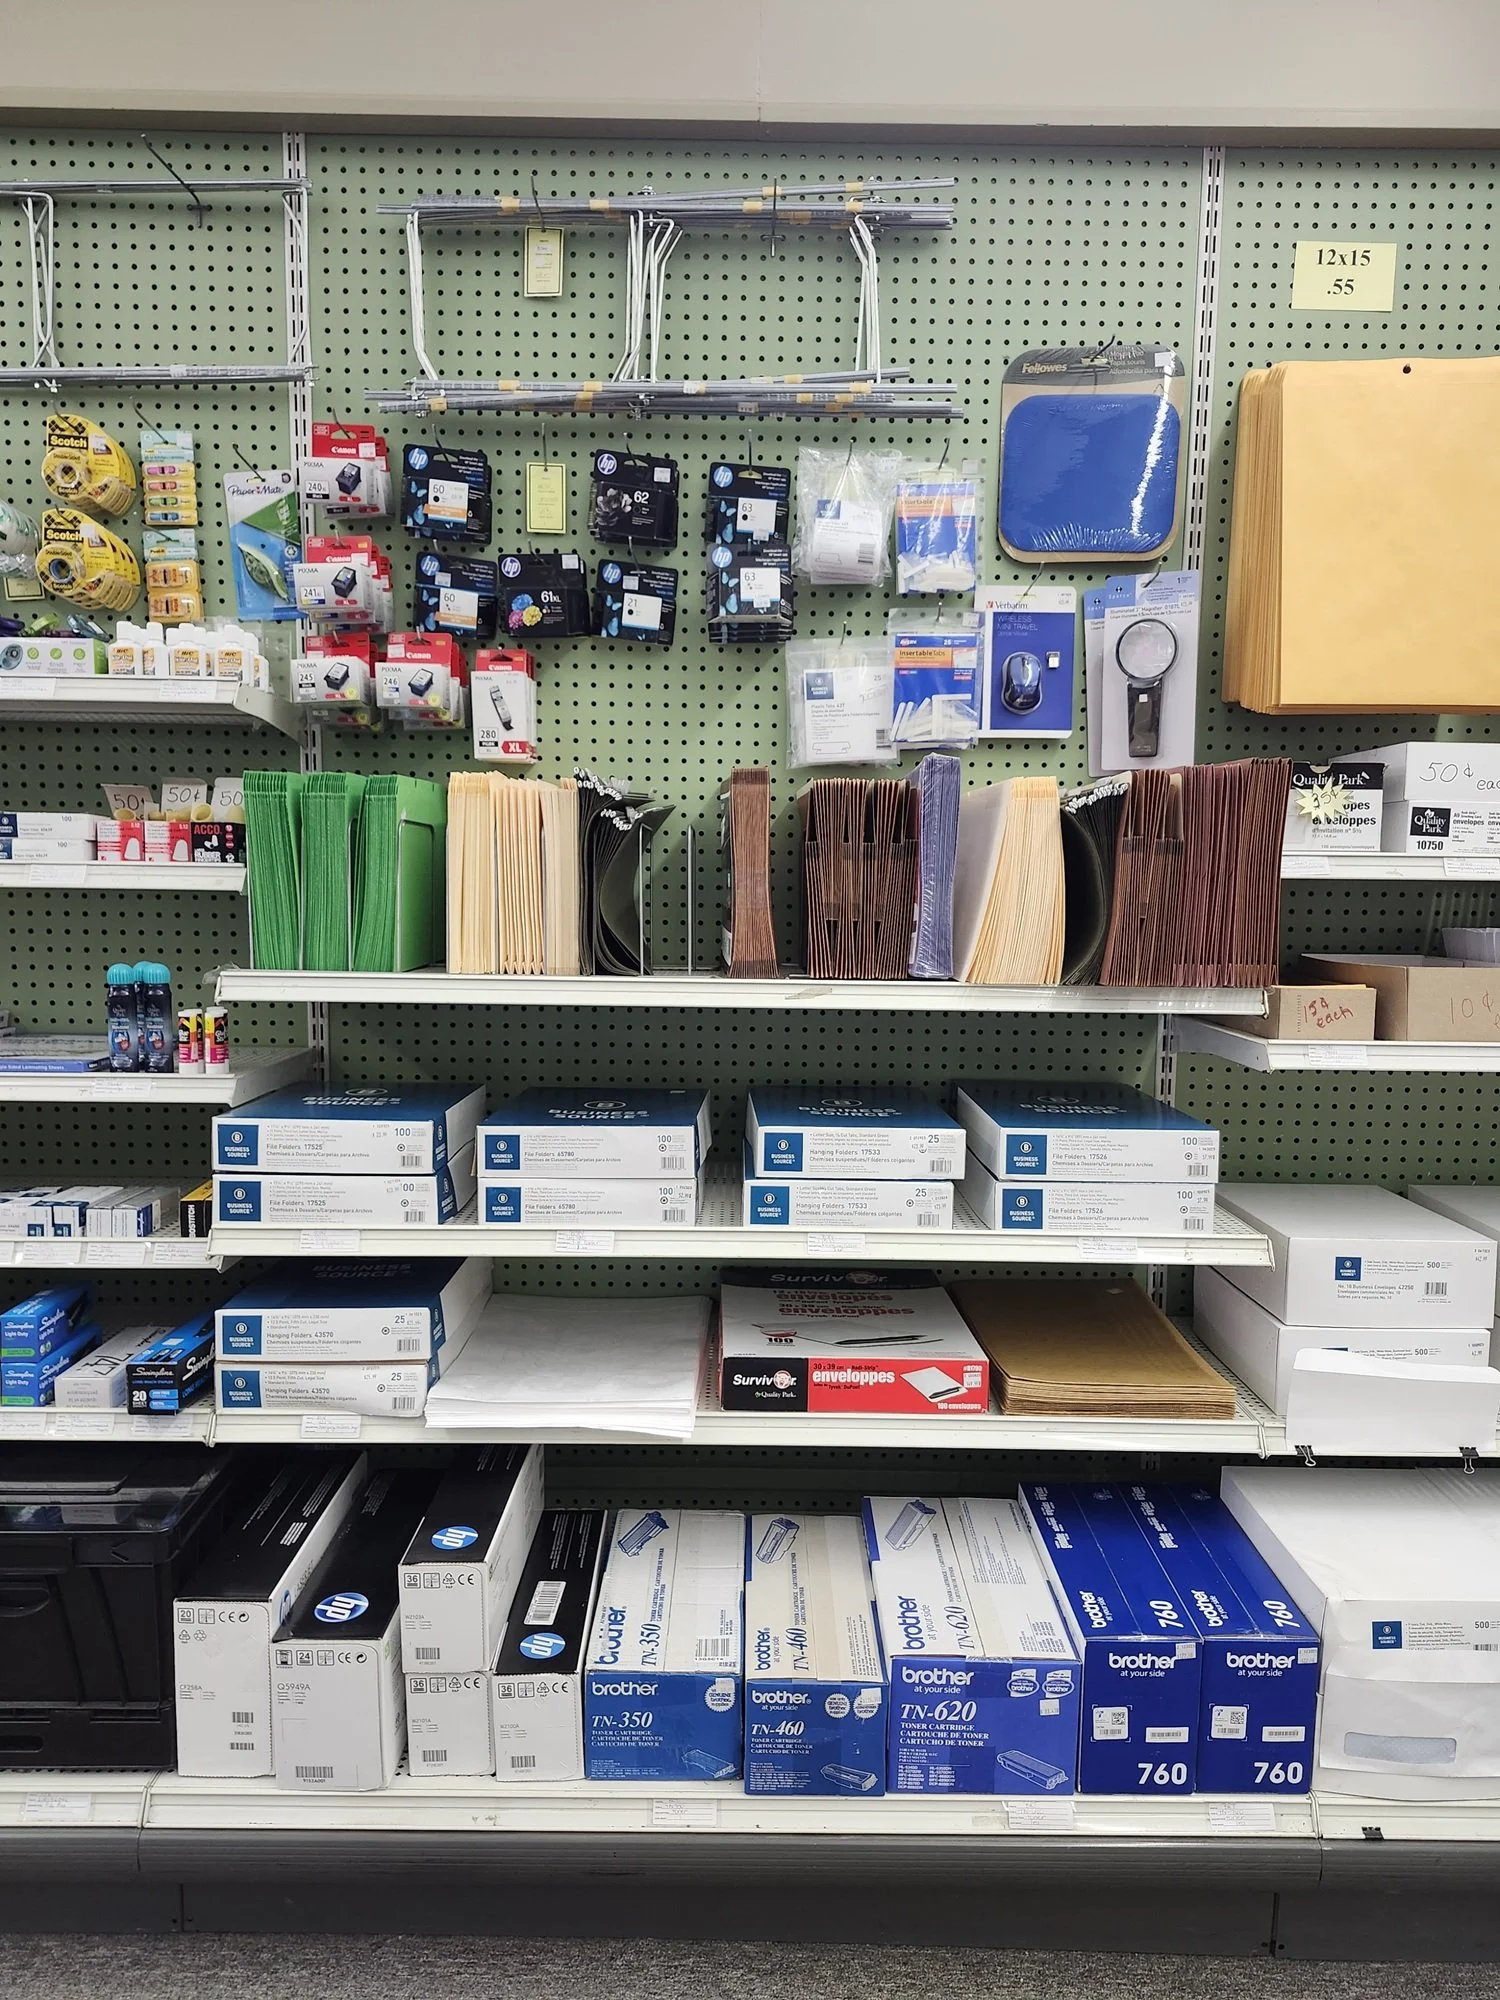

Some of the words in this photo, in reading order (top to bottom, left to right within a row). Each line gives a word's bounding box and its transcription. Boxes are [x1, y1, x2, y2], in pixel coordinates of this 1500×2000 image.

[1317, 248, 1371, 266] 12x15
[1327, 279, 1355, 295] .55
[1021, 362, 1068, 374] Fellowes
[50, 435, 88, 448] Scotch
[331, 445, 357, 454] Canon
[410, 447, 427, 470] hp
[599, 454, 616, 473] hp
[714, 466, 732, 487] hp
[228, 484, 256, 497] Paper
[260, 485, 285, 495] Mate
[308, 482, 322, 492] 240
[433, 484, 445, 494] 60
[633, 491, 650, 504] 62
[742, 503, 753, 512] 63
[46, 529, 82, 541] Scotch
[325, 555, 351, 563] Canon
[713, 546, 731, 568] hp
[423, 556, 439, 576] hp
[503, 558, 519, 577] hp
[604, 563, 620, 583] hp
[744, 572, 755, 581] 63
[304, 588, 317, 598] 241
[443, 593, 455, 603] 60
[627, 597, 637, 607] 21
[994, 601, 1028, 609] Verbatim
[997, 615, 1032, 623] WIRELESS
[997, 623, 1012, 631] MINI
[1013, 623, 1038, 631] TRAVEL
[406, 651, 431, 660] Canon
[488, 663, 512, 672] Canon
[300, 672, 313, 682] 245
[383, 676, 398, 686] 246
[480, 729, 496, 740] 280
[508, 742, 522, 753] XL
[1414, 811, 1447, 827] Quality
[1452, 818, 1485, 826] envelopes
[1422, 823, 1443, 833] Park
[1416, 839, 1444, 851] 10750
[225, 853, 235, 863] 12
[1316, 1005, 1354, 1029] each
[394, 1127, 411, 1137] 100
[657, 1135, 672, 1143] 100
[928, 1134, 940, 1144] 25
[1181, 1137, 1198, 1146] 100
[809, 1149, 834, 1157] Hanging
[835, 1148, 858, 1156] Folders
[915, 1188, 927, 1197] 25
[1177, 1190, 1193, 1200] 100
[796, 1202, 820, 1210] Hanging
[1427, 1261, 1441, 1269] 500
[776, 1292, 893, 1301] envelopes
[778, 1306, 915, 1315] enveloppes
[394, 1315, 405, 1324] 25
[266, 1331, 289, 1339] Hanging
[132, 1367, 175, 1377] Swingline
[812, 1369, 895, 1386] enveloppes
[132, 1390, 147, 1402] 20
[760, 1391, 782, 1400] Quality
[432, 1527, 478, 1549] hp
[406, 1575, 418, 1583] 36
[315, 1592, 368, 1621] hp
[1079, 1590, 1108, 1628] brother
[1191, 1589, 1224, 1627] brother
[179, 1609, 192, 1619] 20
[1149, 1600, 1184, 1628] 760
[1263, 1600, 1301, 1628] 760
[898, 1595, 925, 1651] brother
[944, 1605, 974, 1650] TN-620
[1474, 1620, 1490, 1629] 500
[520, 1633, 565, 1658] hp
[785, 1627, 809, 1672] TN-460
[299, 1652, 311, 1661] 24
[1108, 1652, 1176, 1669] brother
[1226, 1652, 1295, 1669] brother
[901, 1666, 974, 1686] brother
[1120, 1670, 1129, 1678] at
[1129, 1670, 1148, 1679] your
[1149, 1669, 1165, 1678] side
[277, 1682, 311, 1692] Q5949A
[591, 1681, 659, 1697] brother
[914, 1686, 923, 1694] at
[924, 1686, 941, 1696] your
[942, 1685, 961, 1694] side
[751, 1690, 811, 1704] brother
[900, 1700, 977, 1722] TN-620
[591, 1711, 653, 1728] TN-350
[751, 1720, 805, 1736] TN-460
[901, 1722, 927, 1731] TONER
[928, 1723, 975, 1731] CARTRIDGE
[900, 1730, 949, 1738] CARTOUCHE
[949, 1731, 961, 1739] DE
[961, 1731, 989, 1740] TONER
[899, 1738, 944, 1746] CARTUCHO
[956, 1739, 984, 1747] TONER
[1137, 1763, 1187, 1785] 760
[1253, 1762, 1303, 1784] 760
